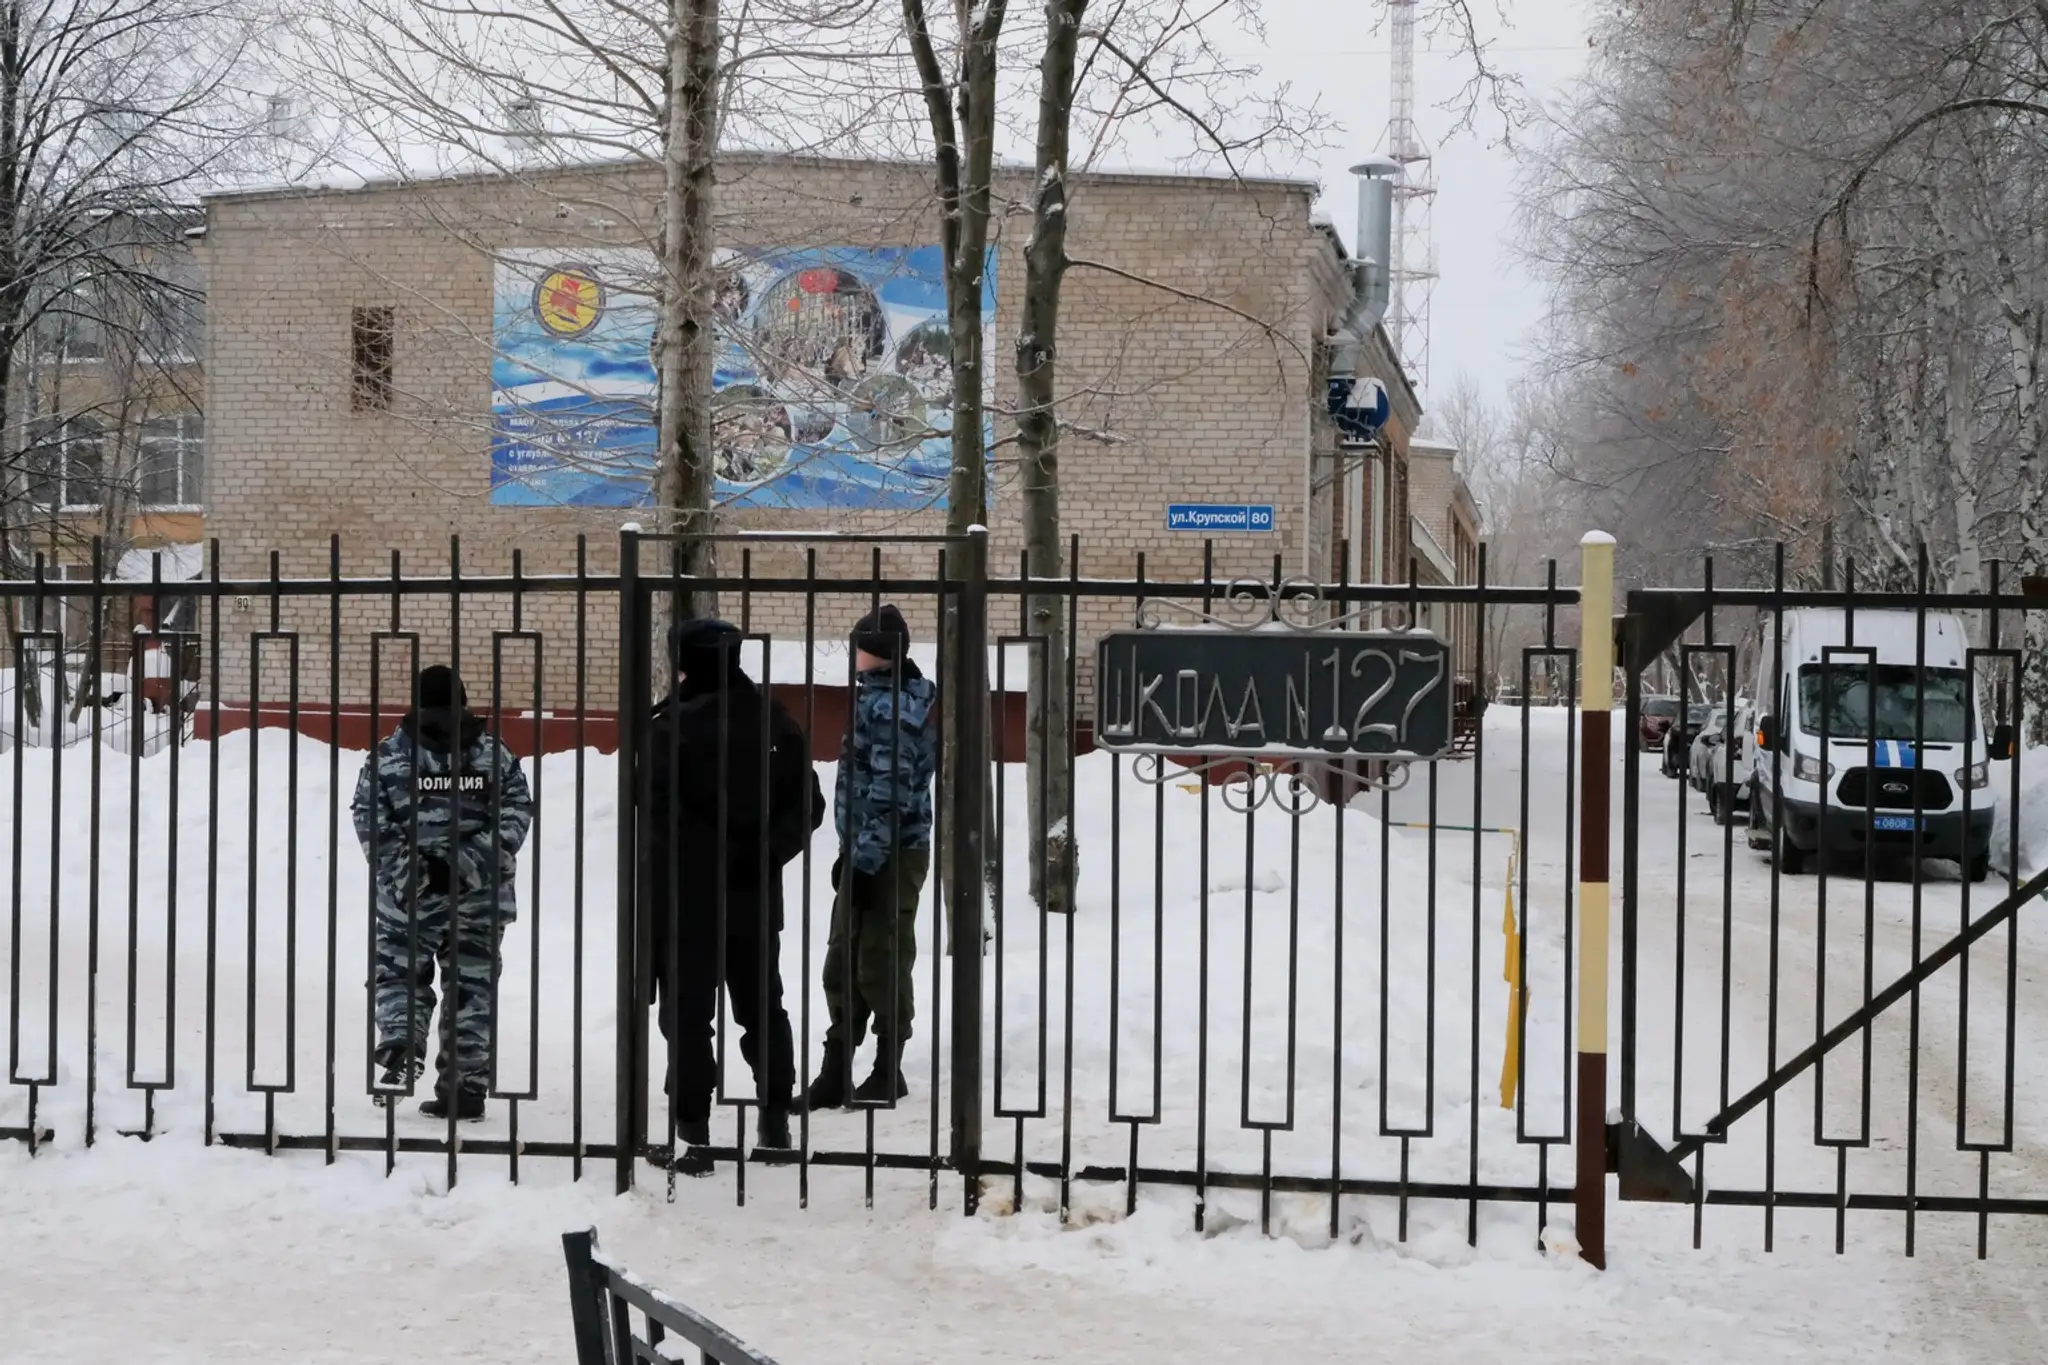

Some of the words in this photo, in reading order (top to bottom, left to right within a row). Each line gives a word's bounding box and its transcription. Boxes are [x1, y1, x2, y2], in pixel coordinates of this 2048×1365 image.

[1171, 511, 1246, 525] ул.Крупской
[1251, 512, 1269, 524] 80
[1103, 643, 1266, 738] ШКОЛА
[1322, 647, 1445, 742] 127
